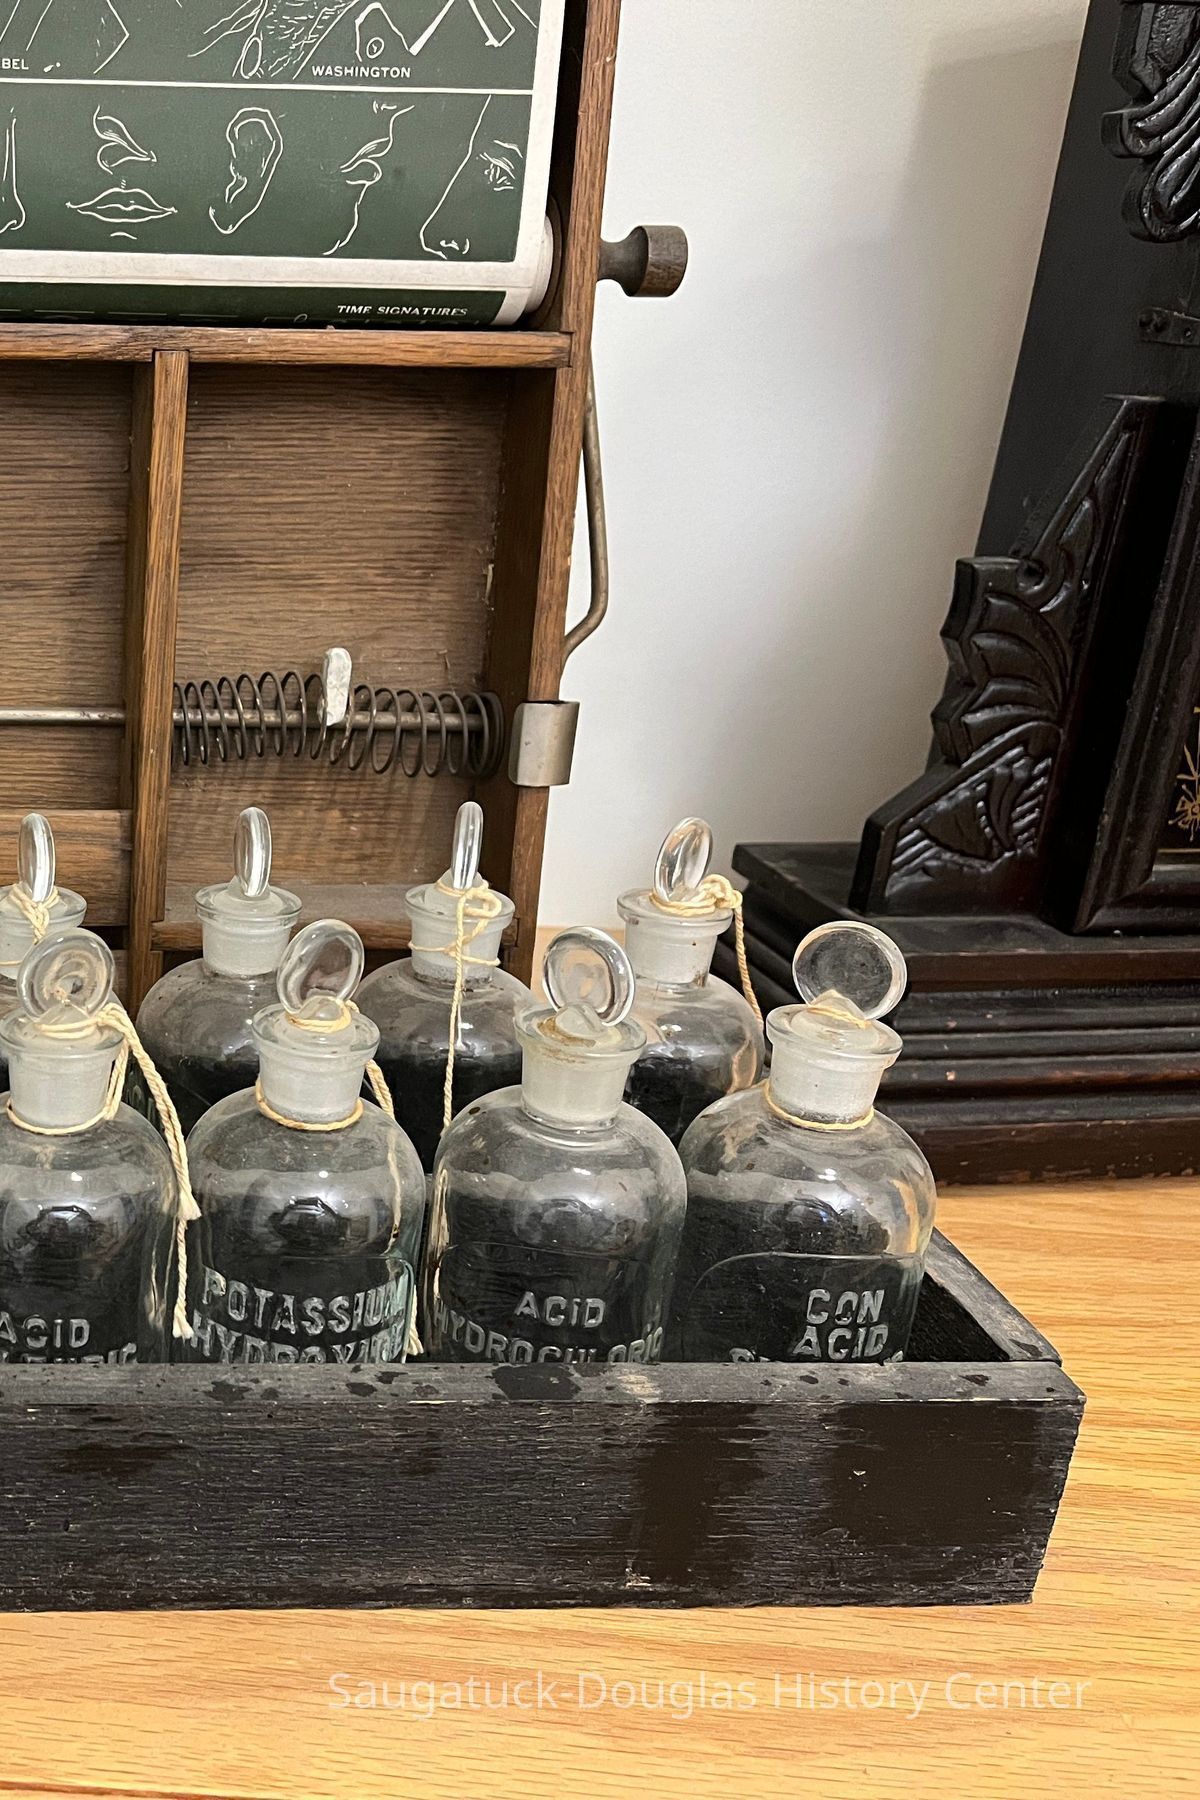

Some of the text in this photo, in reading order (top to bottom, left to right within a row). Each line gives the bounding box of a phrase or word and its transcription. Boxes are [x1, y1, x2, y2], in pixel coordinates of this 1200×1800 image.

[311, 64, 412, 79] WASHINGTON
[337, 305, 468, 317] TIME SIGNATURES
[513, 1291, 606, 1328] ACID
[806, 1288, 886, 1325] CON
[792, 1323, 890, 1360] ACID
